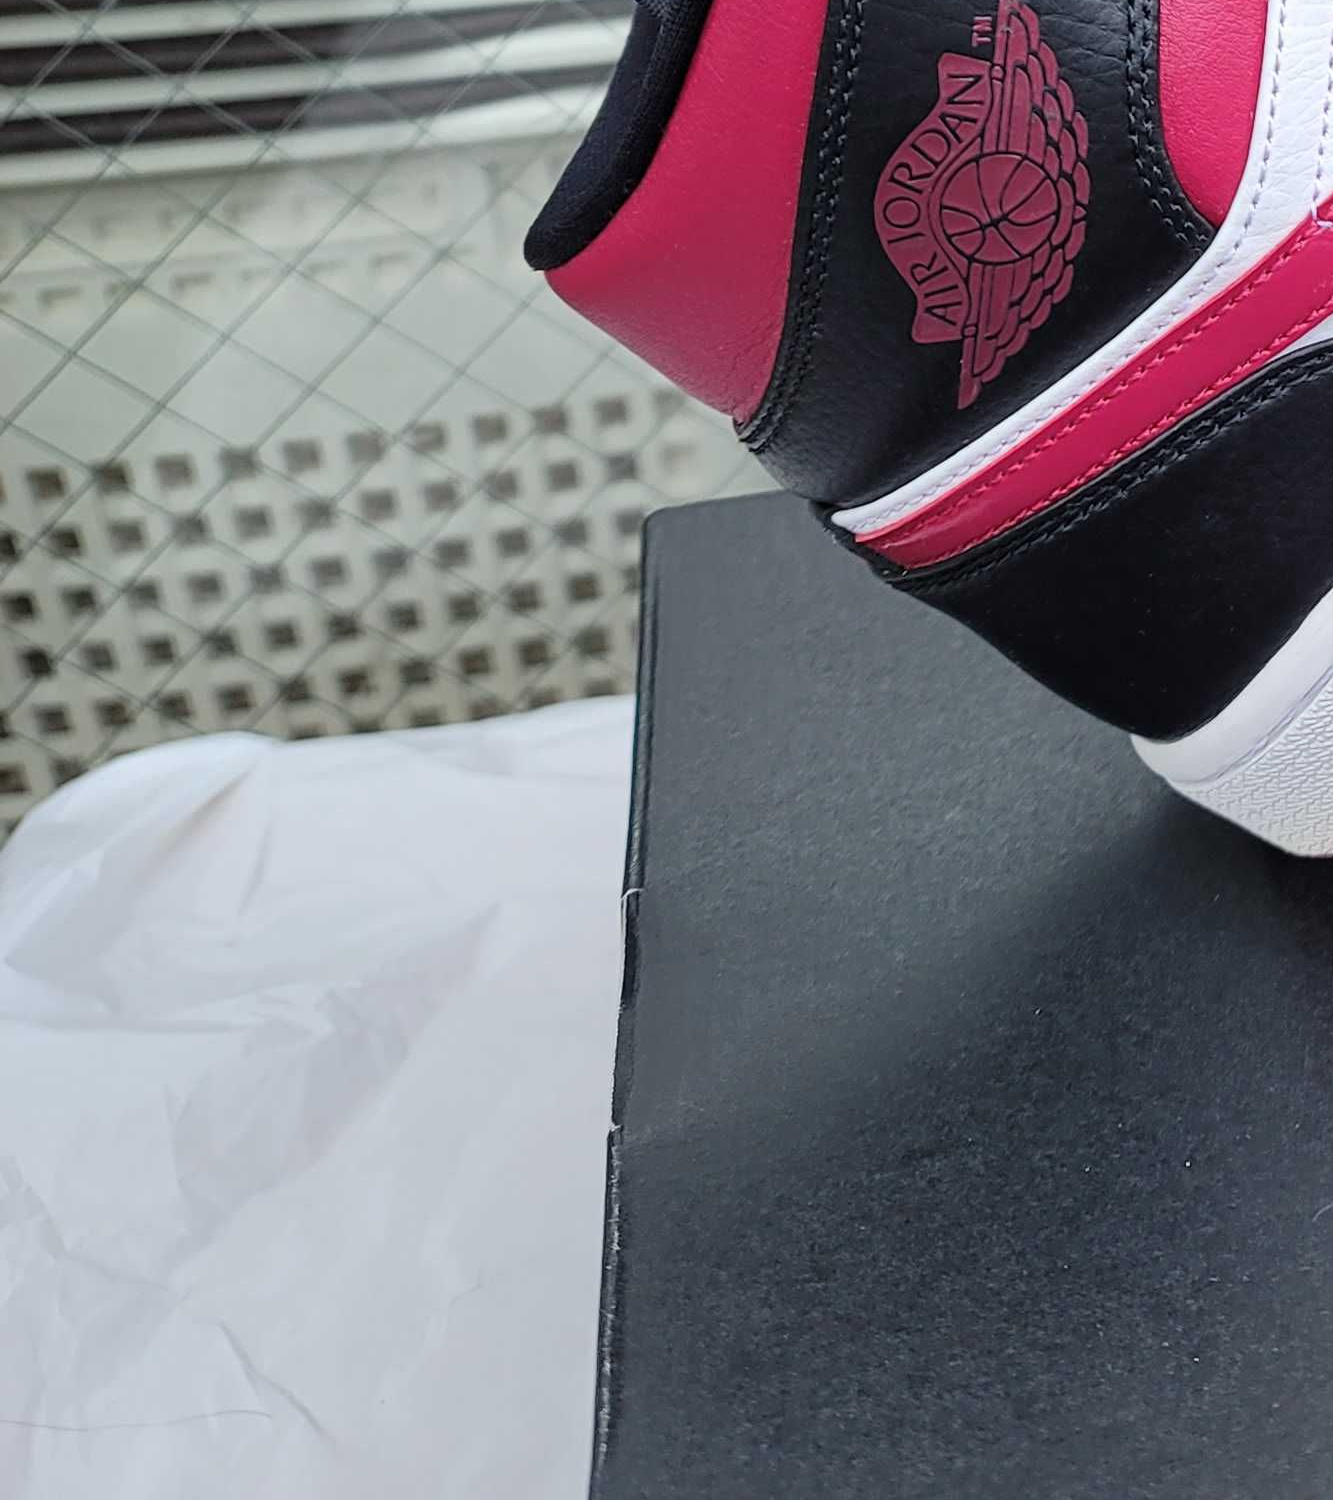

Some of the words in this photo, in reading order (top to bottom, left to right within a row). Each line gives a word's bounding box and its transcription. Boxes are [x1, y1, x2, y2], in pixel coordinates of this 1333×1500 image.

[971, 16, 992, 47] TM
[883, 73, 985, 244] JORDAN
[909, 251, 963, 326] AIR
